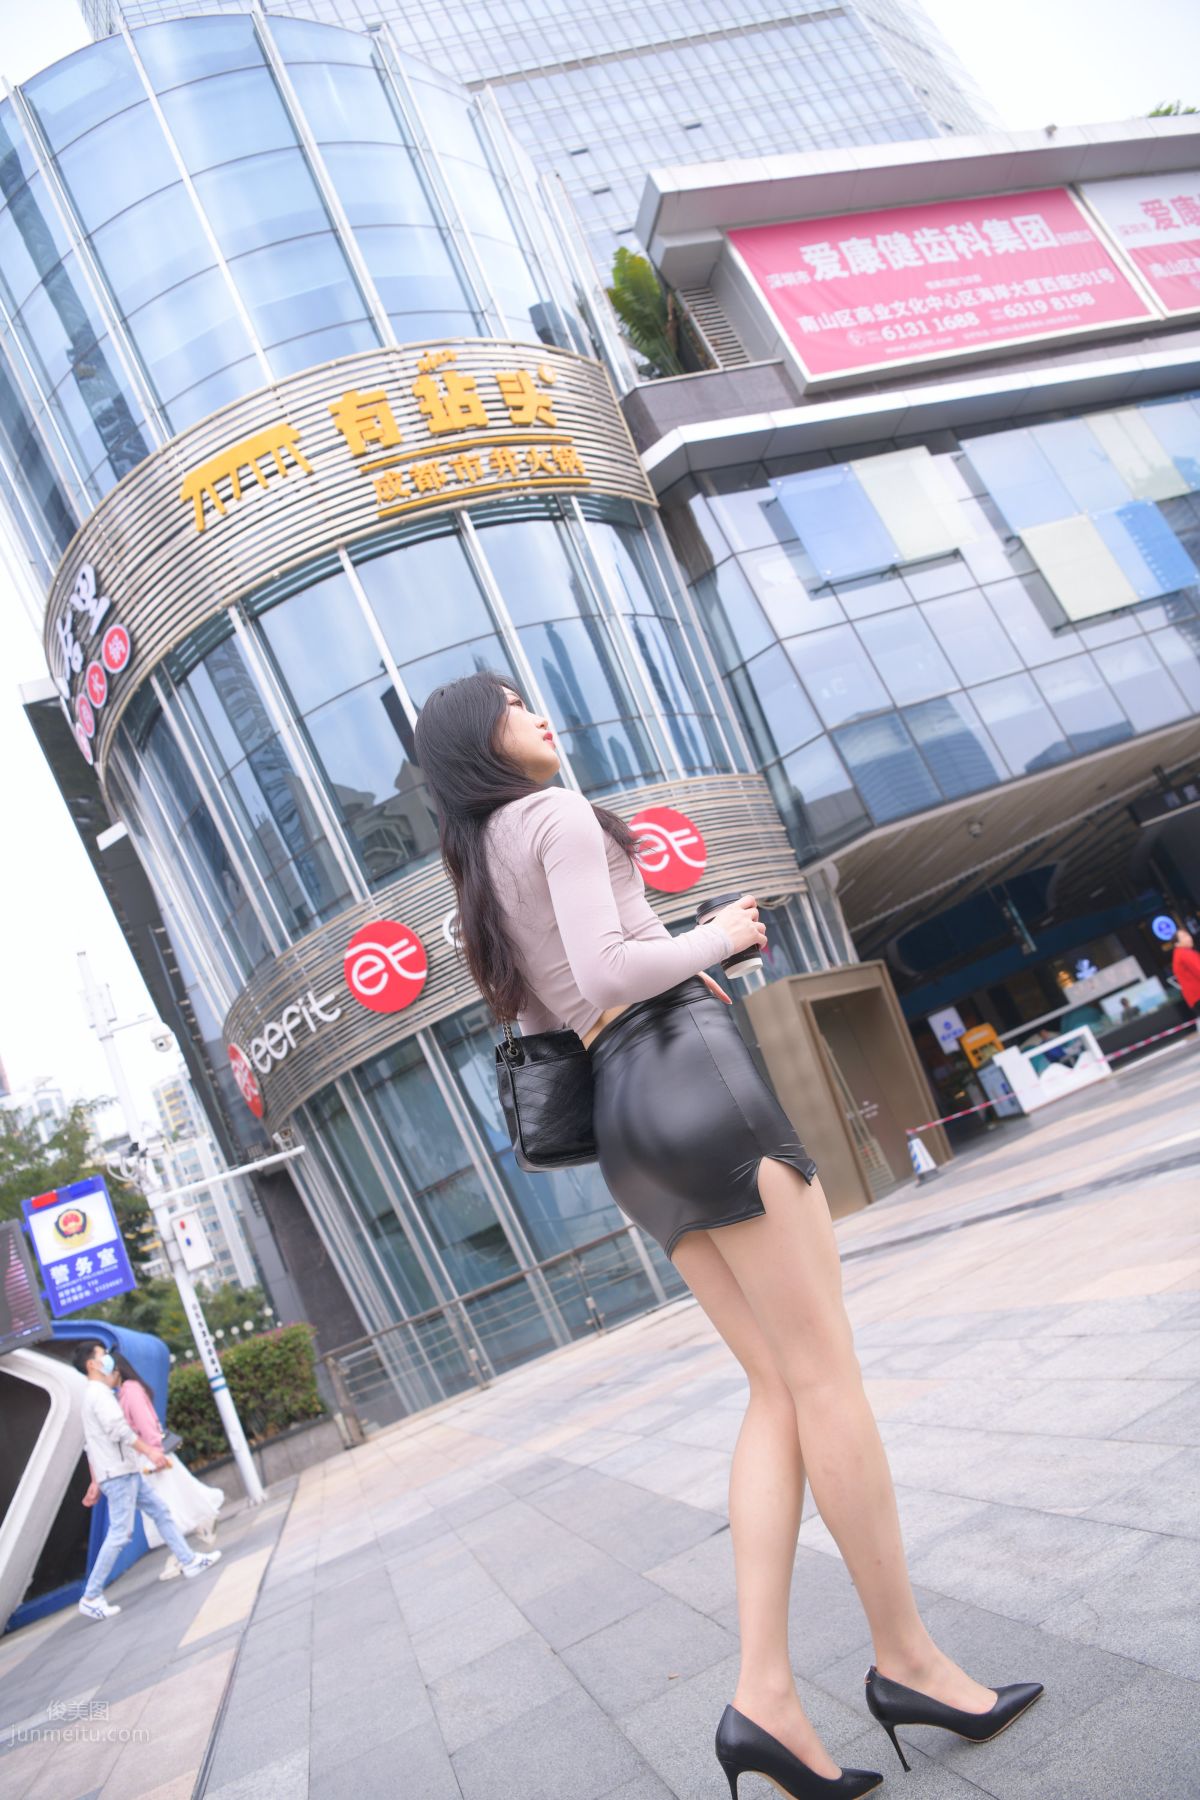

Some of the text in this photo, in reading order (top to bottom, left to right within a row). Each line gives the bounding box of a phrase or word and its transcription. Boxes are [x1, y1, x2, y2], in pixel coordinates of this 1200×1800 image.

[799, 213, 1060, 282] 爱康健齿科集团
[880, 319, 931, 341] 6131
[932, 311, 980, 332] 1688
[1002, 299, 1049, 319] 6319
[373, 446, 586, 504] 成都市井火锅
